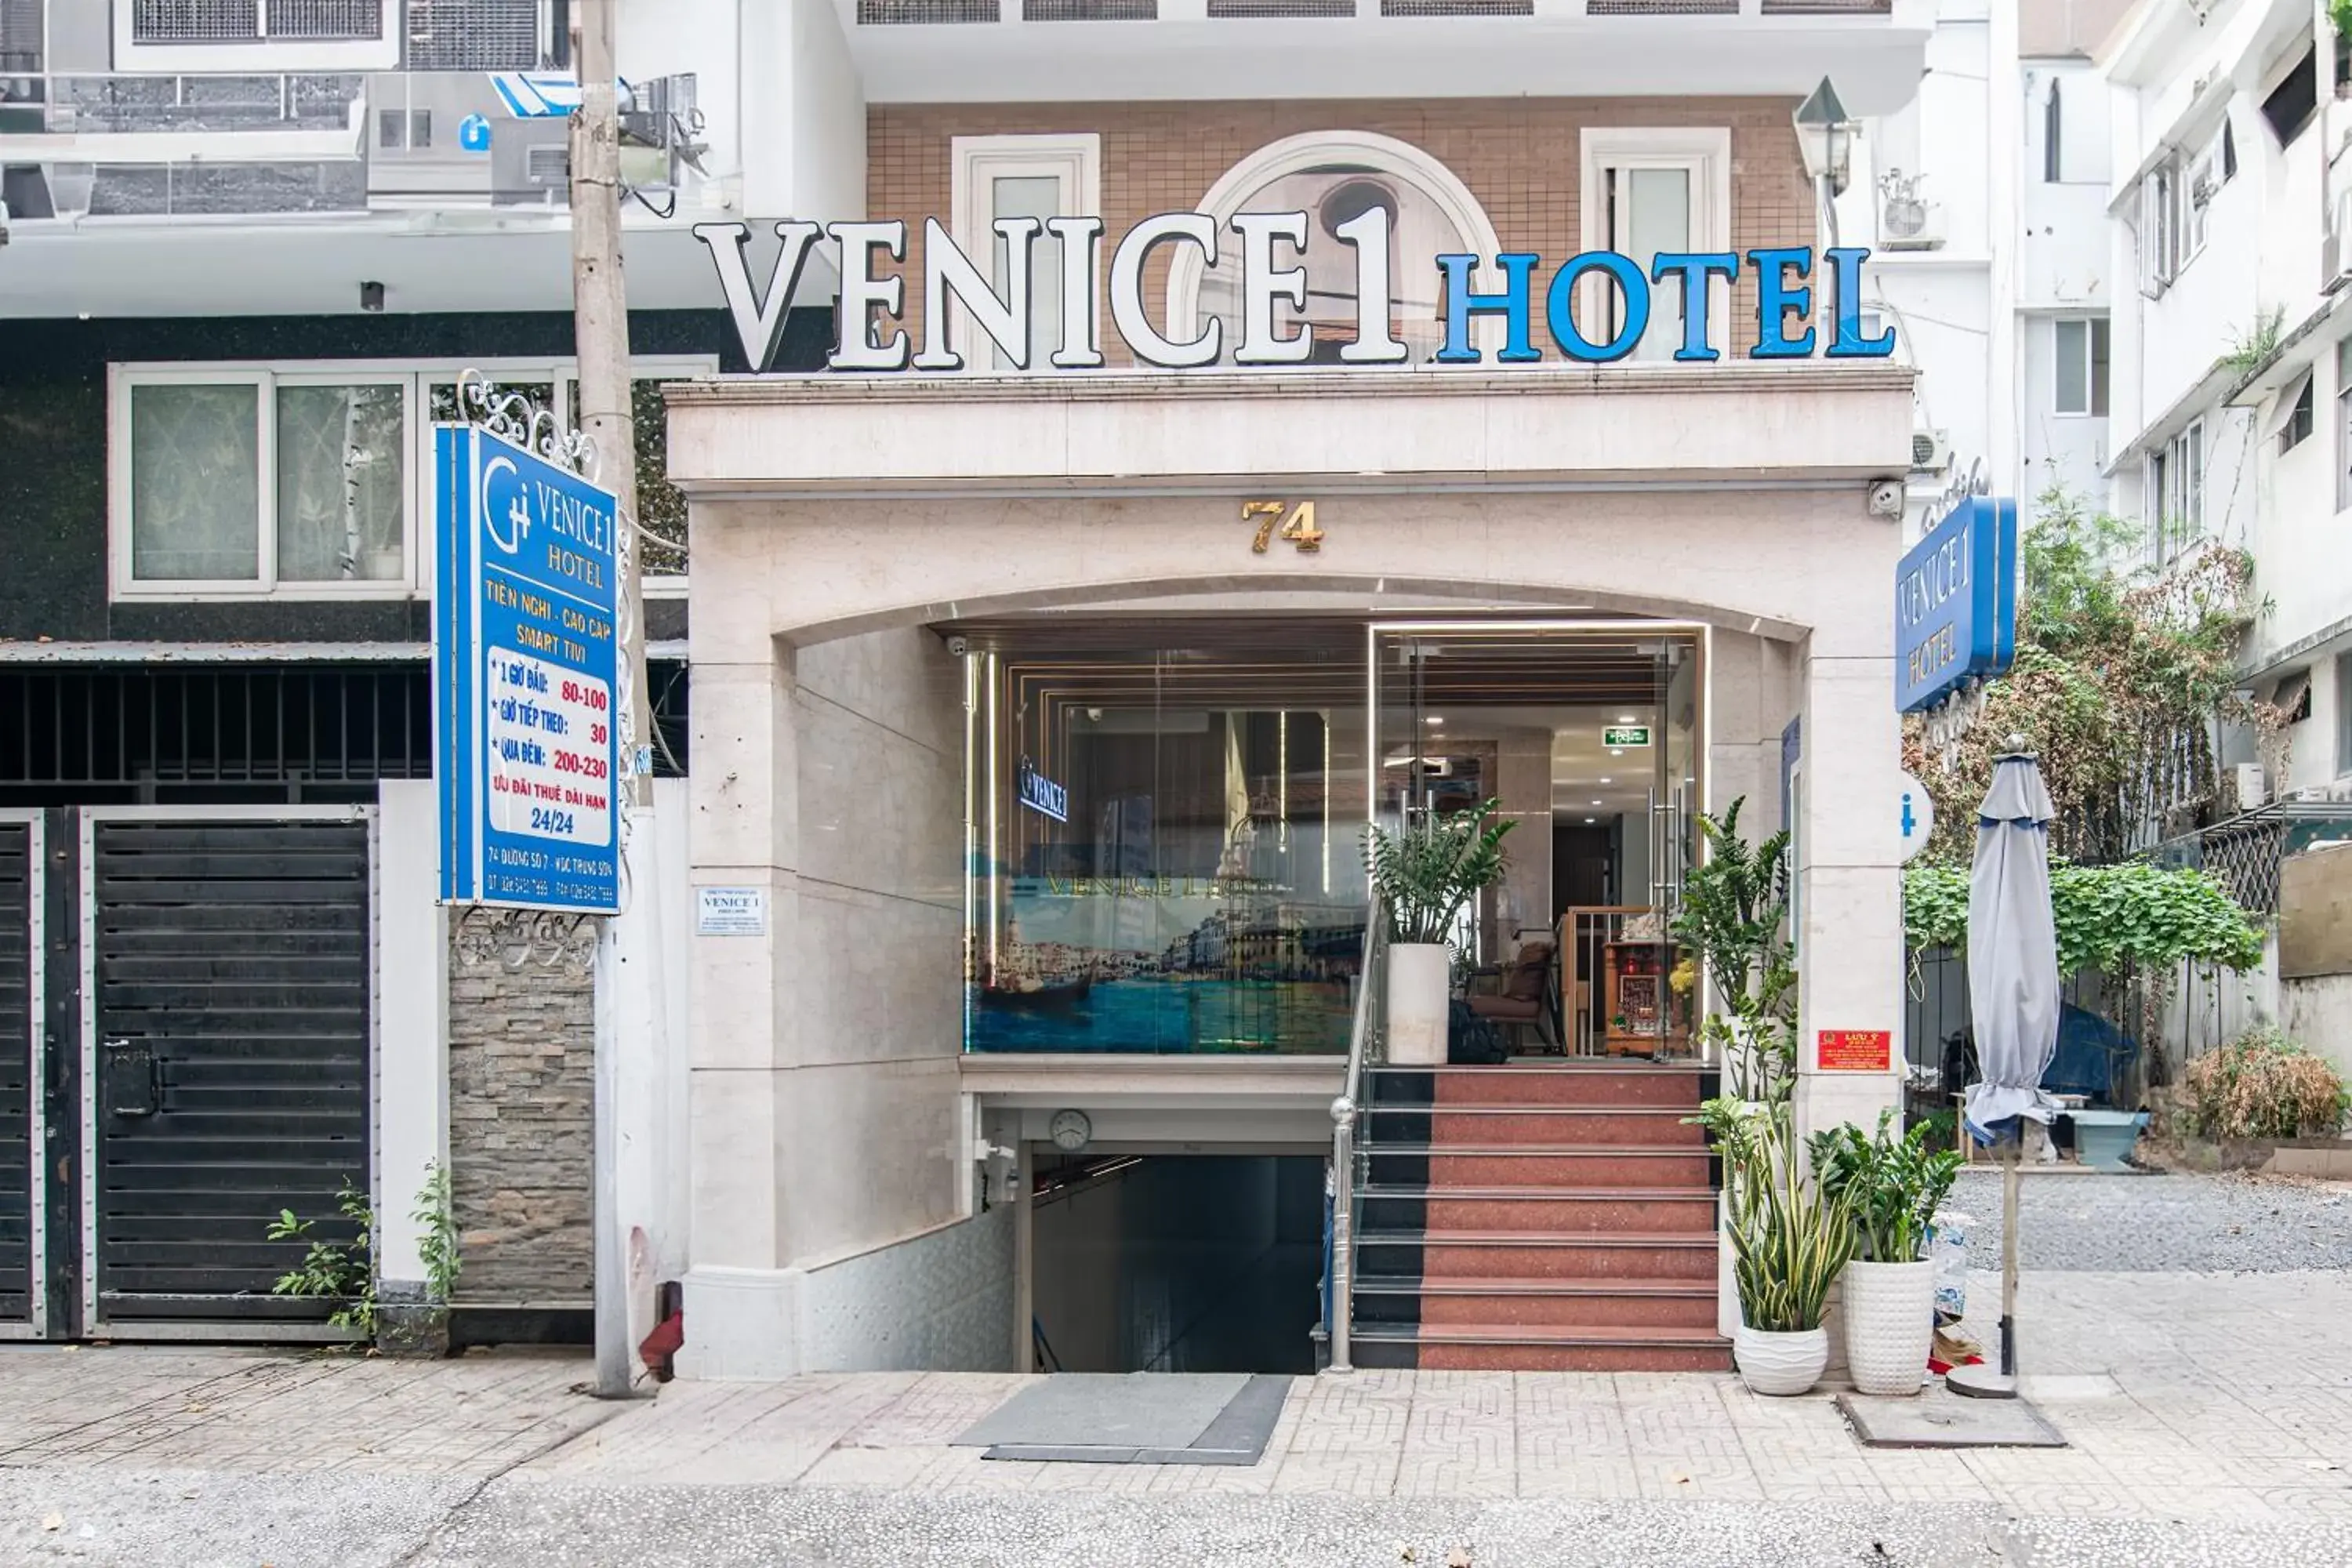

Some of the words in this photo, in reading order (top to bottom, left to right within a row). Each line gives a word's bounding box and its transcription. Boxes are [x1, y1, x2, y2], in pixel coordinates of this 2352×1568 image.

[1436, 245, 1897, 363] HOTEL
[1243, 500, 1324, 555] 74
[548, 543, 604, 590] HOTEL
[521, 592, 551, 621] NGHI
[562, 608, 586, 633] CAO
[517, 623, 559, 656] SMART
[564, 639, 587, 665] TIVI
[1907, 622, 1956, 688] HOTEL
[501, 663, 506, 683] 1
[561, 679, 606, 712] 80-100
[518, 700, 539, 728] TIẾP
[590, 724, 607, 746] 30
[501, 738, 519, 763] QUA
[554, 750, 608, 779] 200-230
[531, 808, 574, 834] 24/24
